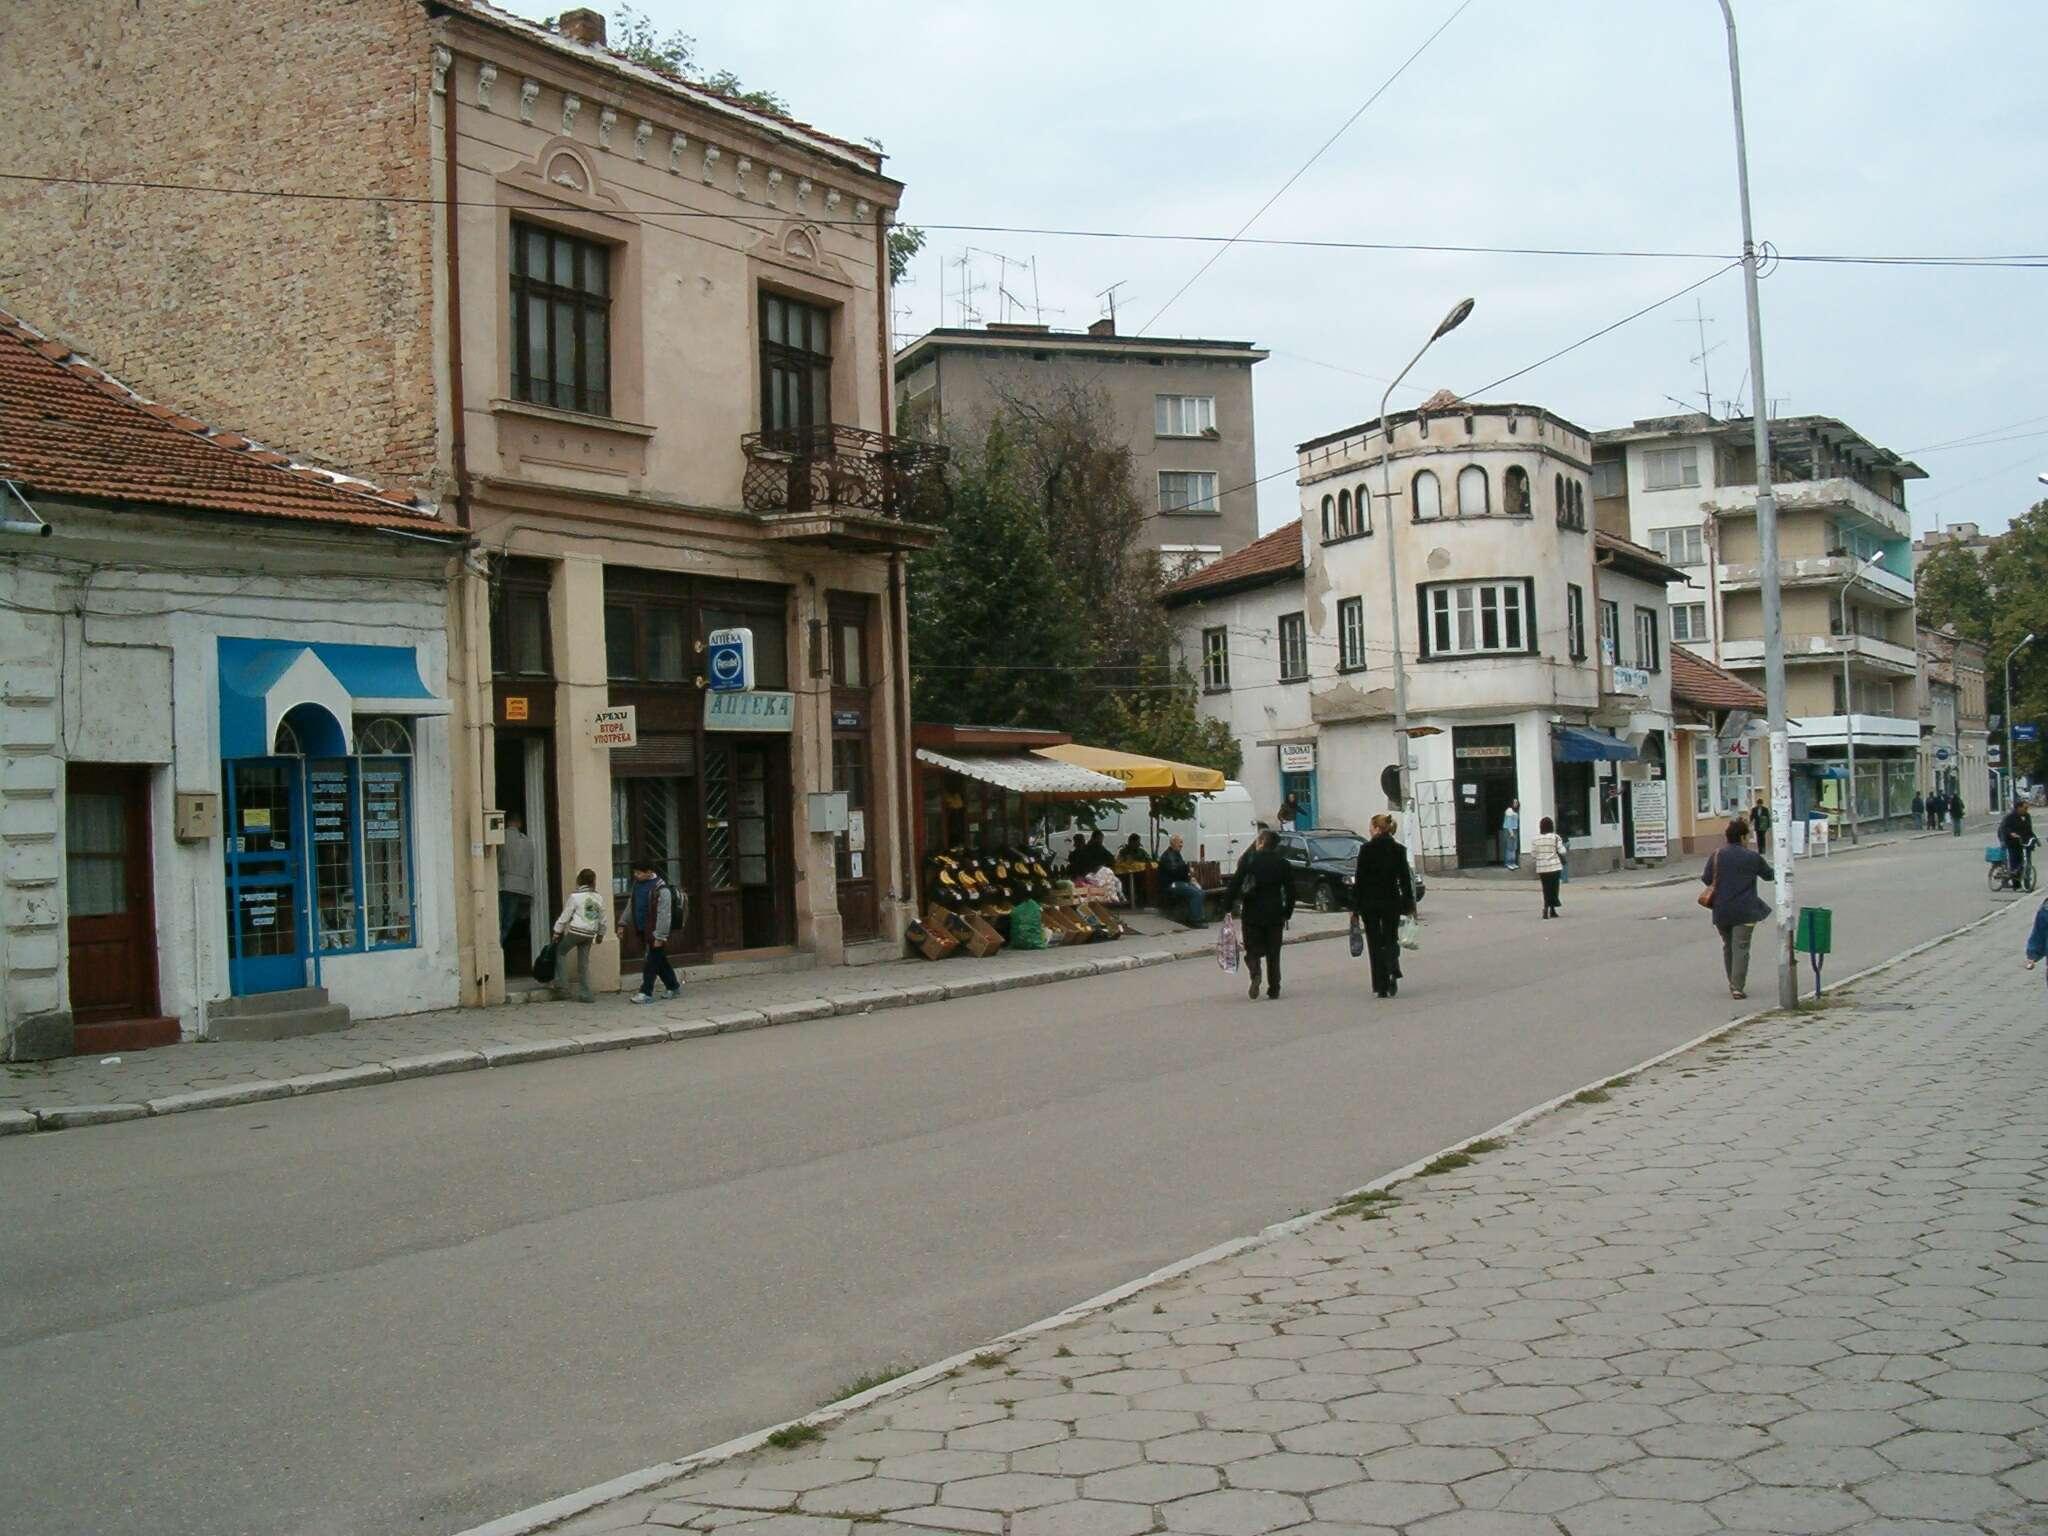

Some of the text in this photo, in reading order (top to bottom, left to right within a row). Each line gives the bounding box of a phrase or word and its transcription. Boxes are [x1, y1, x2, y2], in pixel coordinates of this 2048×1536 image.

[711, 633, 741, 645] АПТЕКА
[711, 695, 788, 716] АПТЕКА
[600, 723, 624, 733] ВТОРА
[594, 733, 632, 744] УПОТРЕБА
